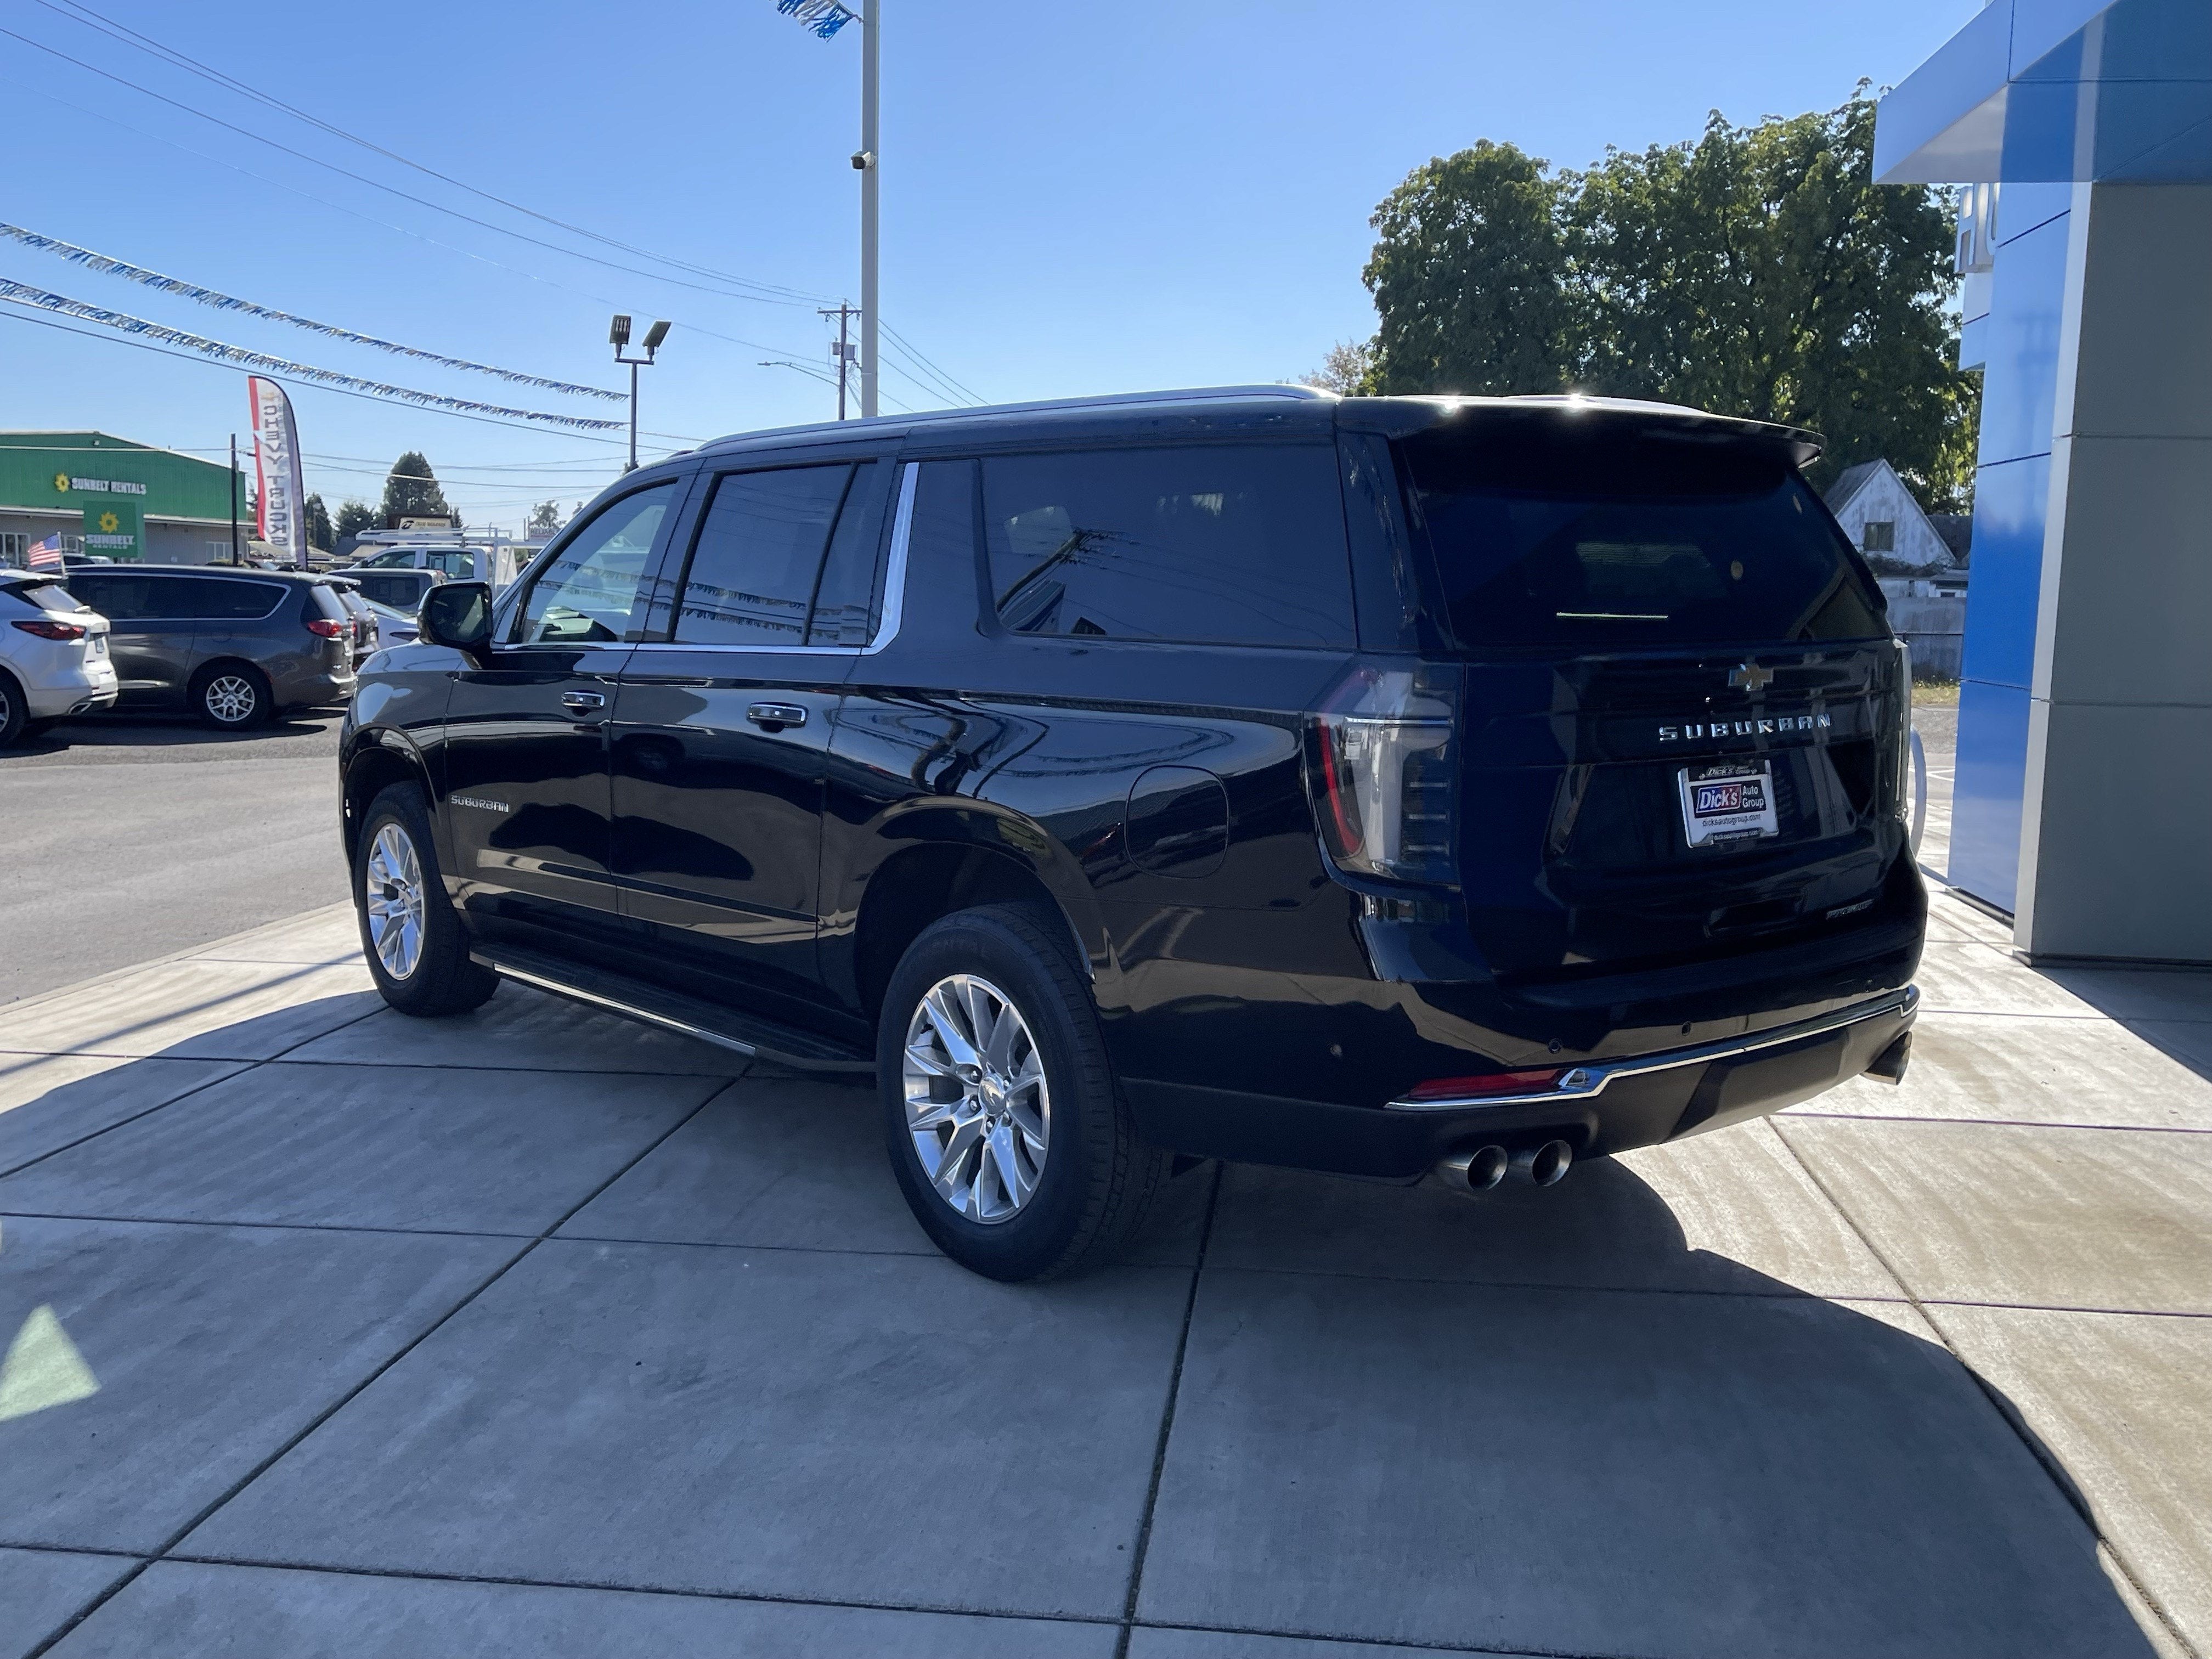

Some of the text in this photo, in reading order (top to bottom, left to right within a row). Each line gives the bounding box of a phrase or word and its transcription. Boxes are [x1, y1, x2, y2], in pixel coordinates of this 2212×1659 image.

[71, 477, 146, 495] SUNBELT RENTALS
[86, 534, 134, 545] SUNBELT
[1659, 714, 1831, 741] SUBURBAN
[1700, 788, 1737, 809] Dick's
[1742, 786, 1758, 795] Auto
[451, 794, 509, 812] SUBURBAN
[1742, 798, 1764, 809] Group
